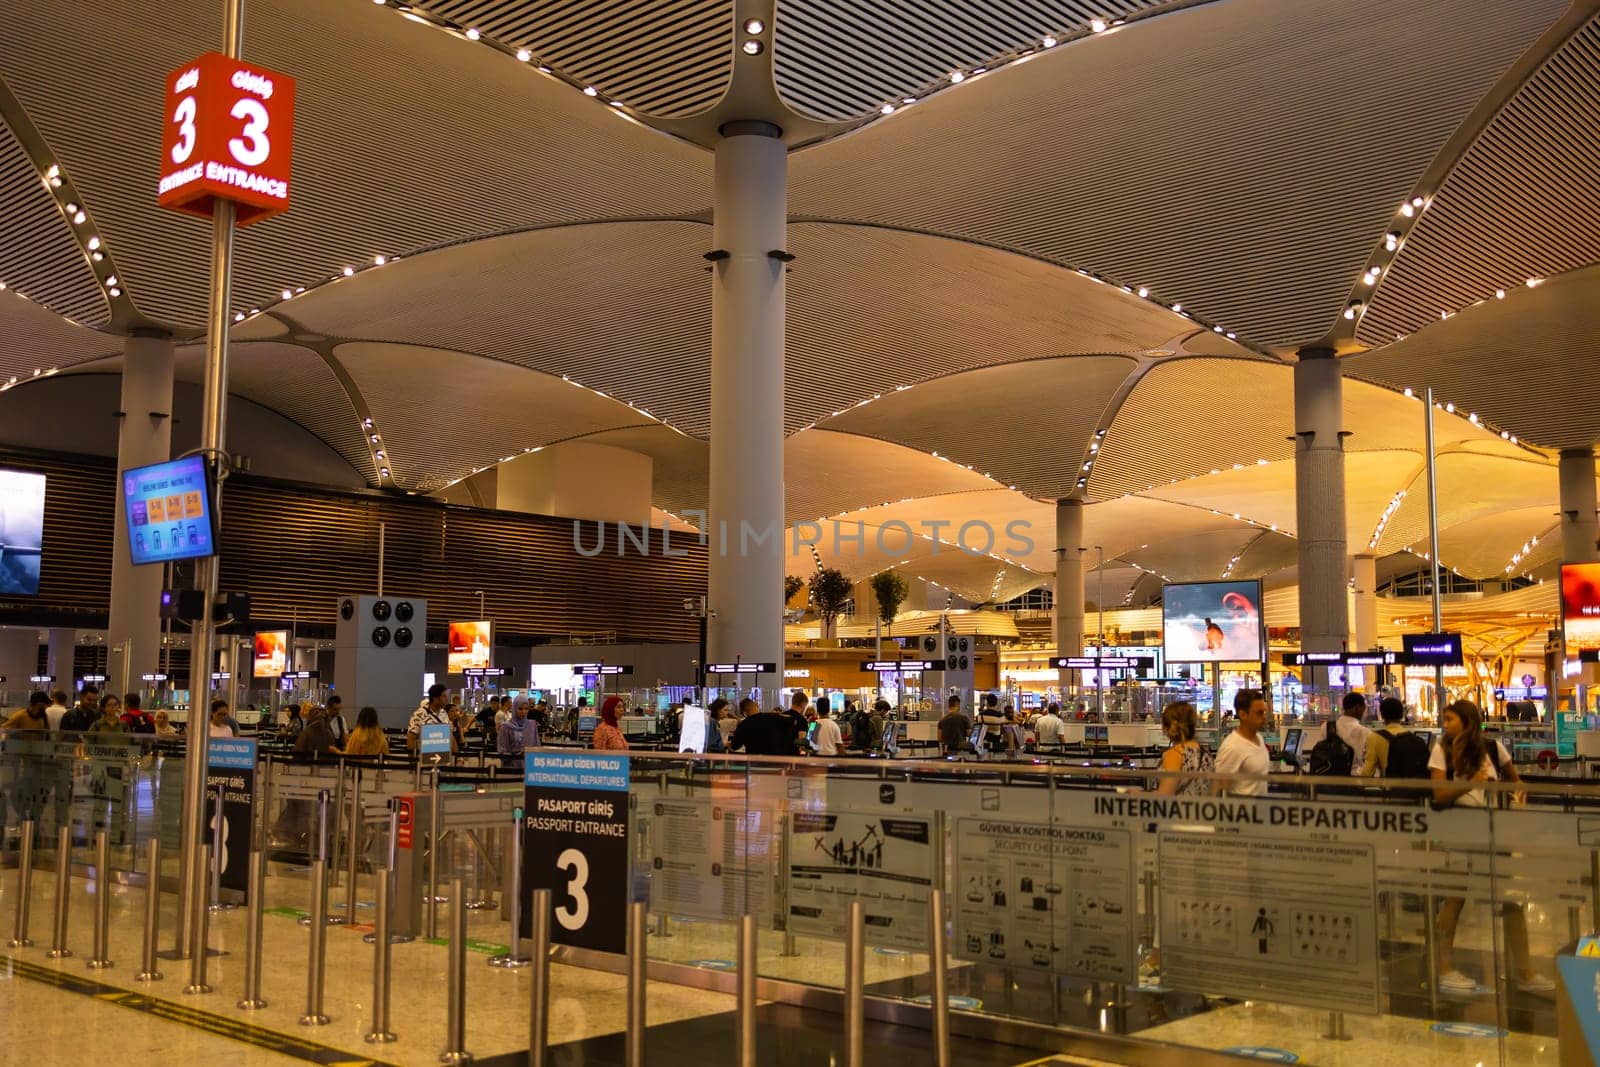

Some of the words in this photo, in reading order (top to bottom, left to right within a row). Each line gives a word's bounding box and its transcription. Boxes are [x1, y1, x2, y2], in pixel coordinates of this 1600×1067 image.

[171, 95, 197, 164] 3
[228, 97, 271, 167] 3
[205, 161, 288, 199] ENTRANCE
[546, 757, 574, 769] HATLAR
[574, 755, 596, 769] GİDEN
[596, 760, 620, 771] YOLCU
[207, 775, 229, 788] SAPORT
[527, 772, 580, 785] INTERNATIONAL
[580, 774, 626, 787] DEPARTURES
[224, 791, 252, 804] NTRANCE
[537, 798, 586, 815] PASAPORT
[587, 799, 614, 819] GİRİŞ
[1094, 796, 1264, 826] INTERNATIONAL
[1268, 805, 1430, 835] DEPARTURES
[526, 816, 574, 833] PASSPORT
[574, 819, 625, 838] ENTRANCE
[979, 822, 1022, 835] GÜVENLİK
[1022, 826, 1064, 840] KONTROL
[1064, 830, 1106, 842] NOKTASI
[994, 838, 1032, 851] SECURITY
[1062, 845, 1090, 857] POINT
[555, 848, 590, 931] 3
